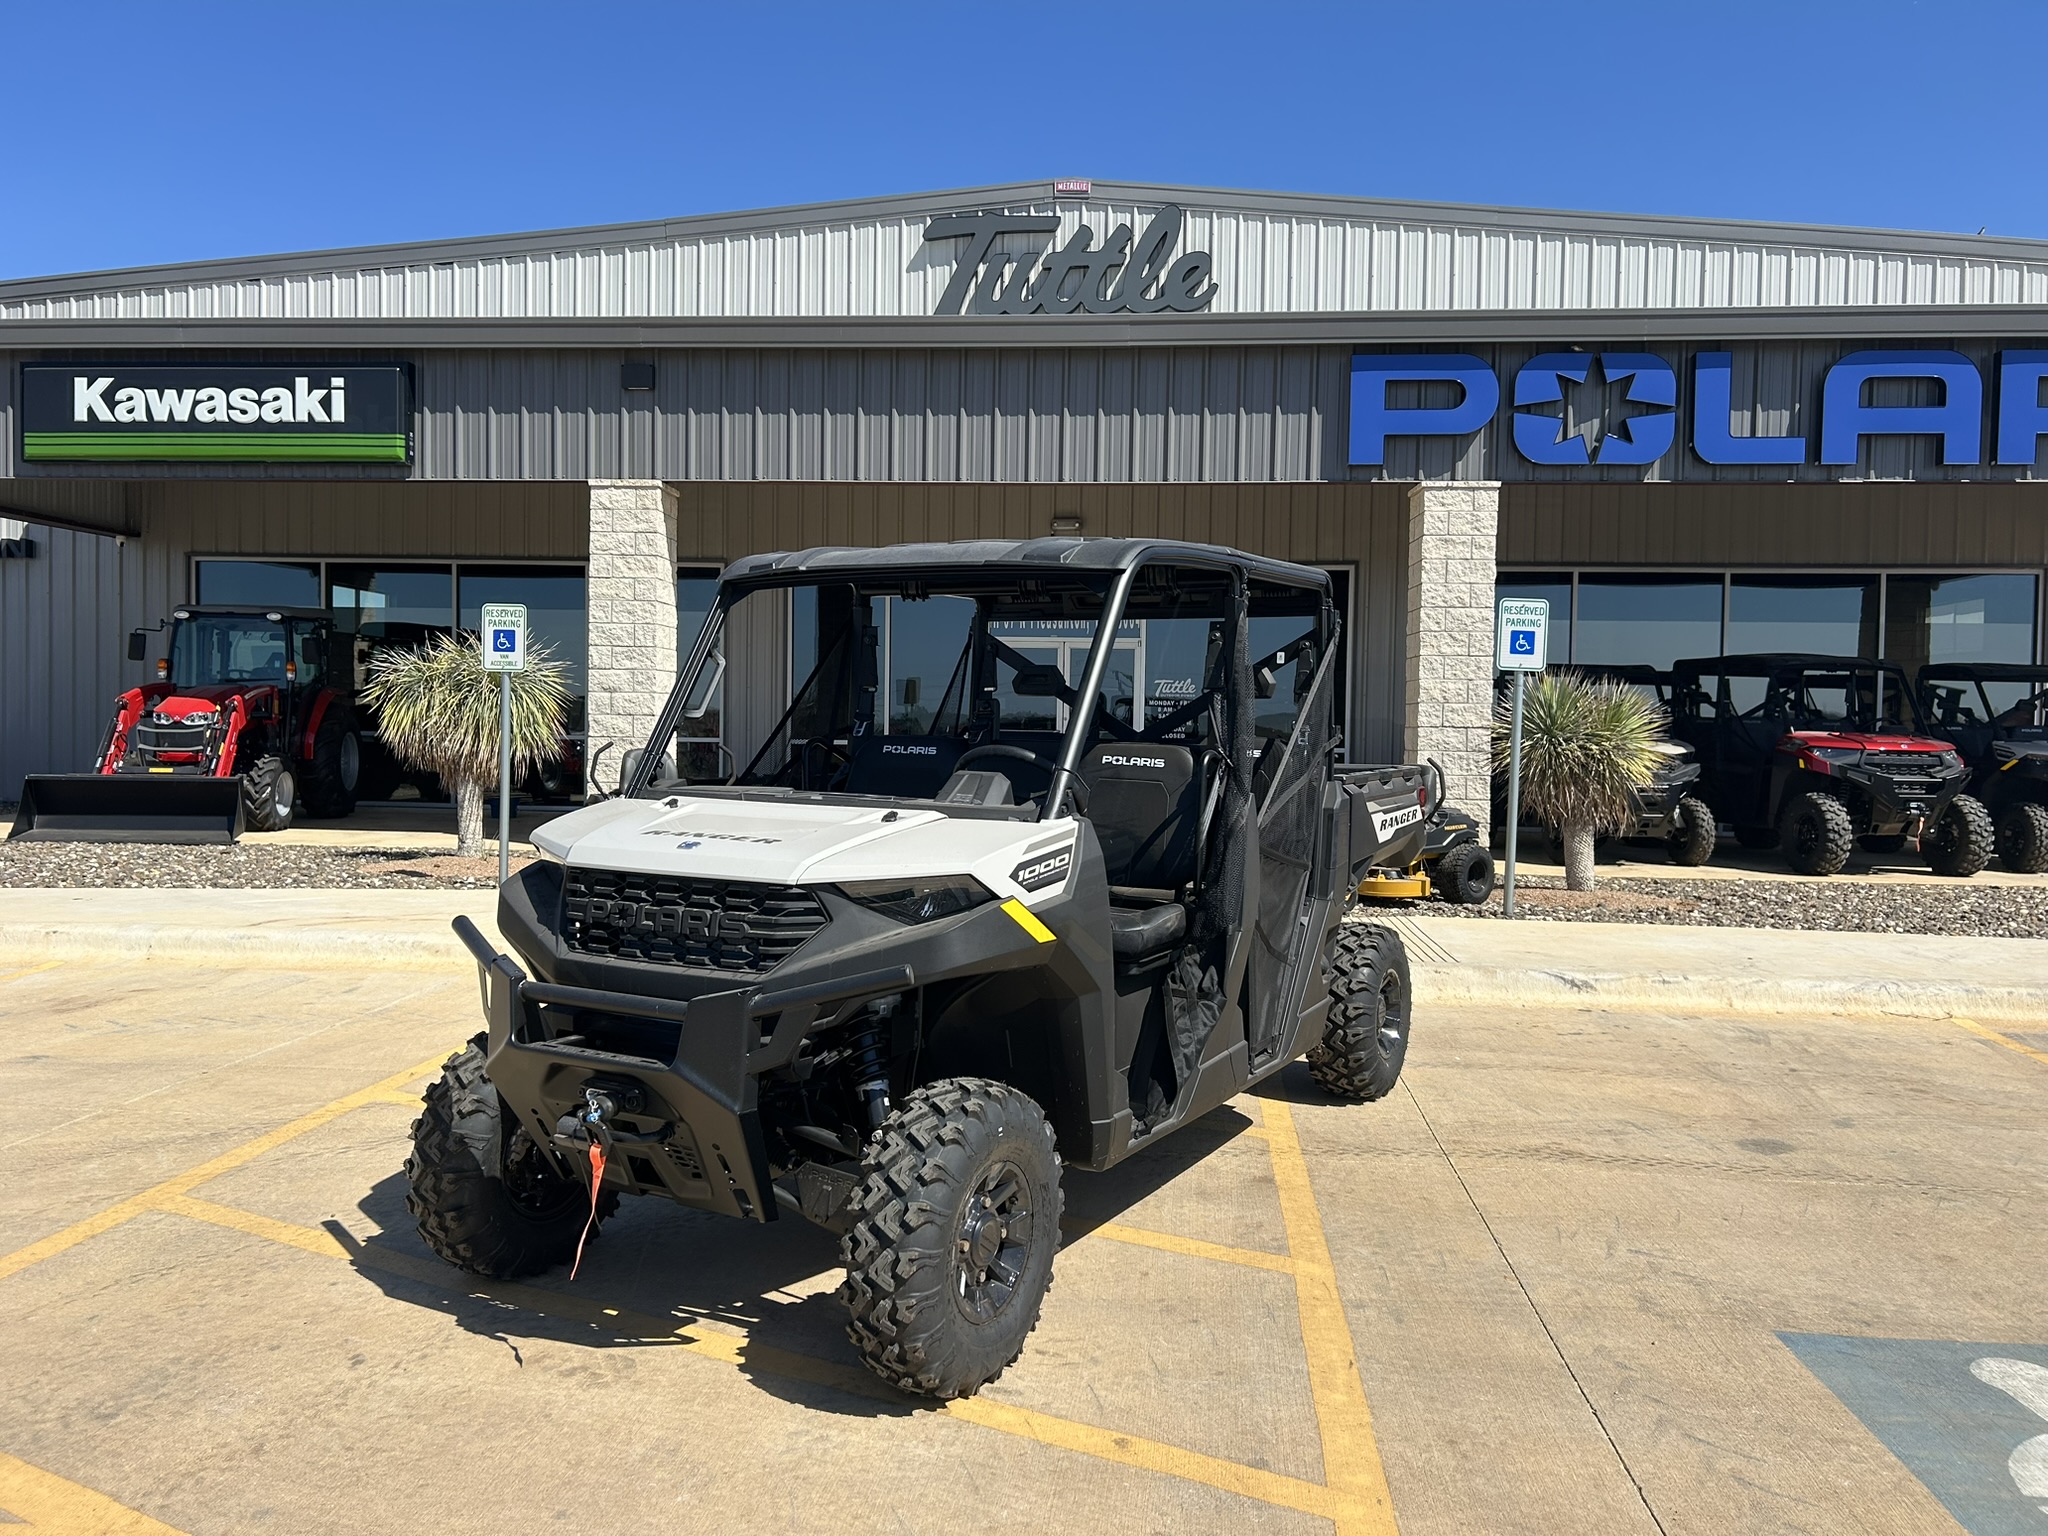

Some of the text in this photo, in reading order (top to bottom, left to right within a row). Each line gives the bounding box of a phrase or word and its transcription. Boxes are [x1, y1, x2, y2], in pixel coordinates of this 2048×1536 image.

[1057, 182, 1088, 191] METALLIC
[923, 204, 1218, 315] Tuttle
[73, 377, 345, 423] Kawasaki
[485, 609, 524, 618] RESERVED
[1503, 605, 1545, 616] RESERVED
[487, 619, 521, 628] PARKING
[1505, 618, 1542, 628] PARKING
[1154, 678, 1196, 698] Tuttle
[882, 745, 937, 755] POLARIS
[1101, 755, 1165, 768] POLARIS
[1379, 808, 1418, 832] RANGER
[640, 830, 783, 844] RANGER
[1017, 853, 1070, 882] 1000
[585, 898, 749, 939] POLARIS
